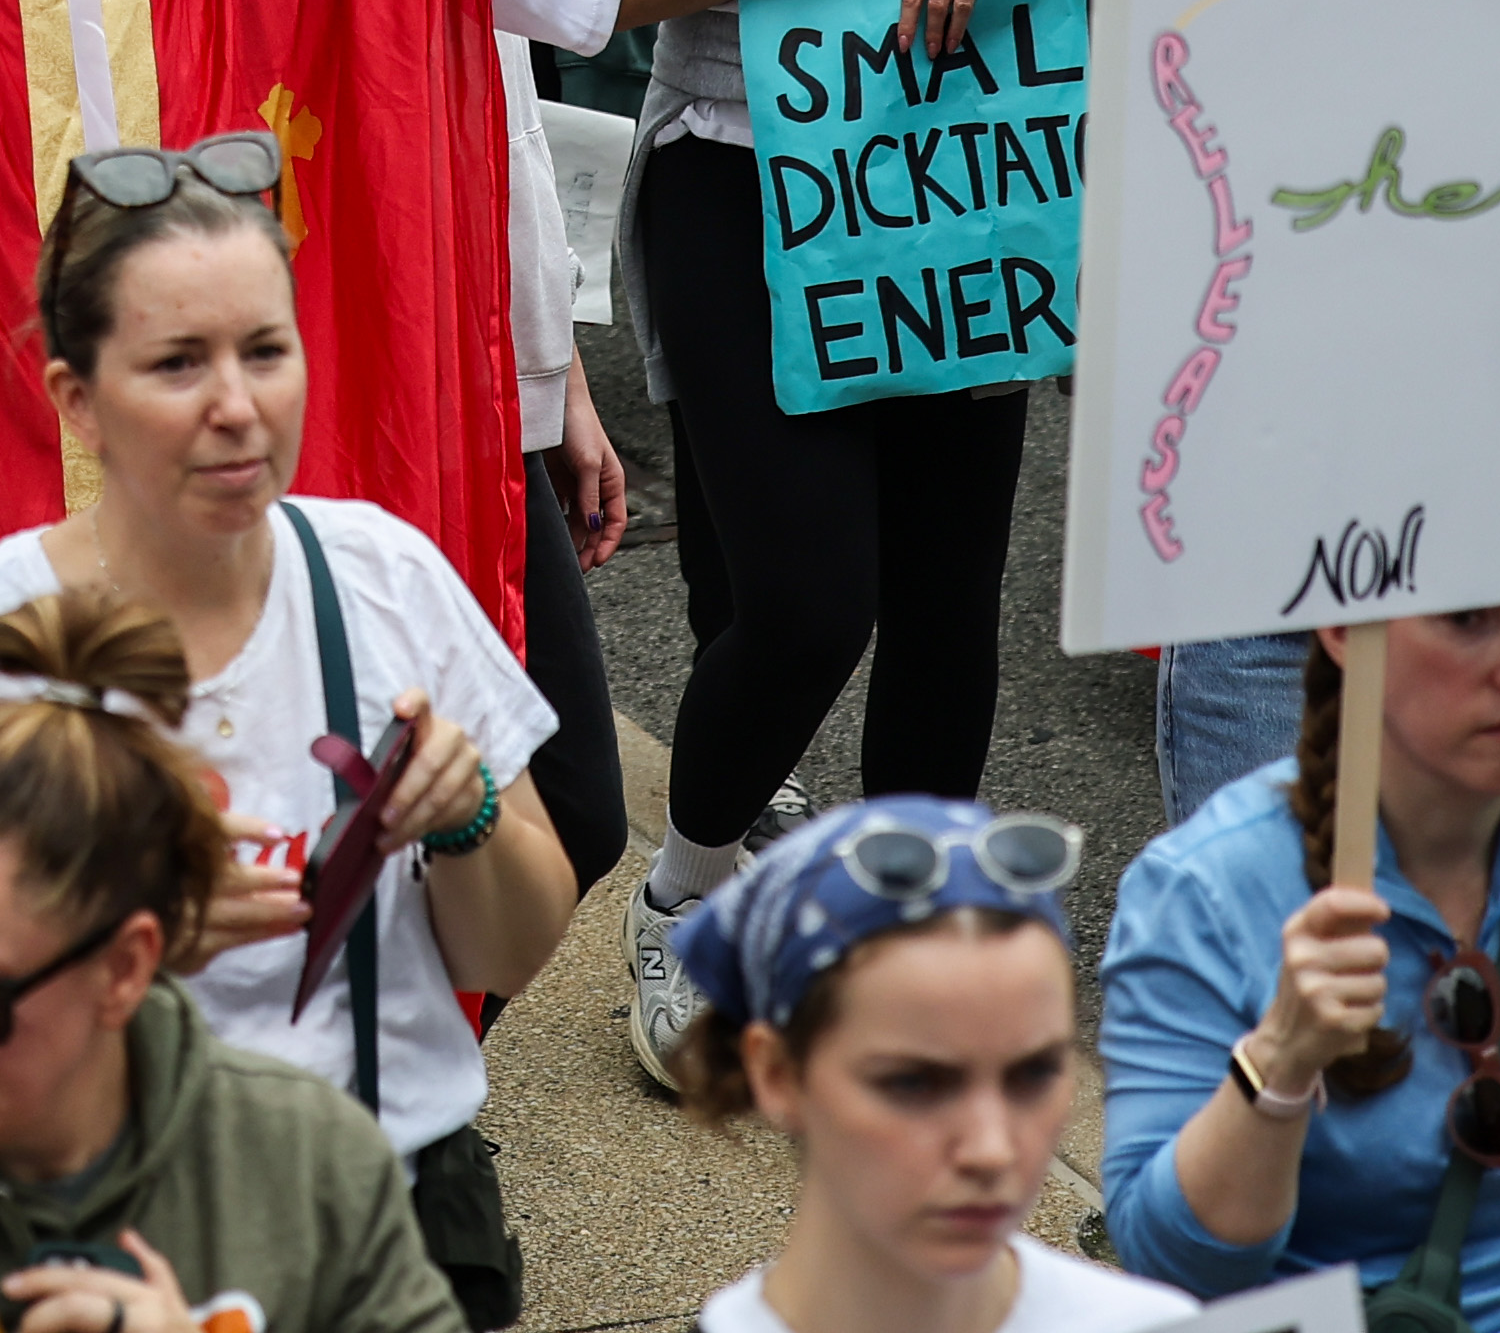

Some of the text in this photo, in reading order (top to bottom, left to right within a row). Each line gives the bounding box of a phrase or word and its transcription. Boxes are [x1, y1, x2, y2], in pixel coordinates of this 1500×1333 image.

[775, 1, 1093, 126] SMAL
[768, 107, 1089, 252] DICKTAT
[803, 257, 1079, 382] ENER
[1139, 29, 1255, 565] RELEASE
[1280, 503, 1427, 620] NOW!
